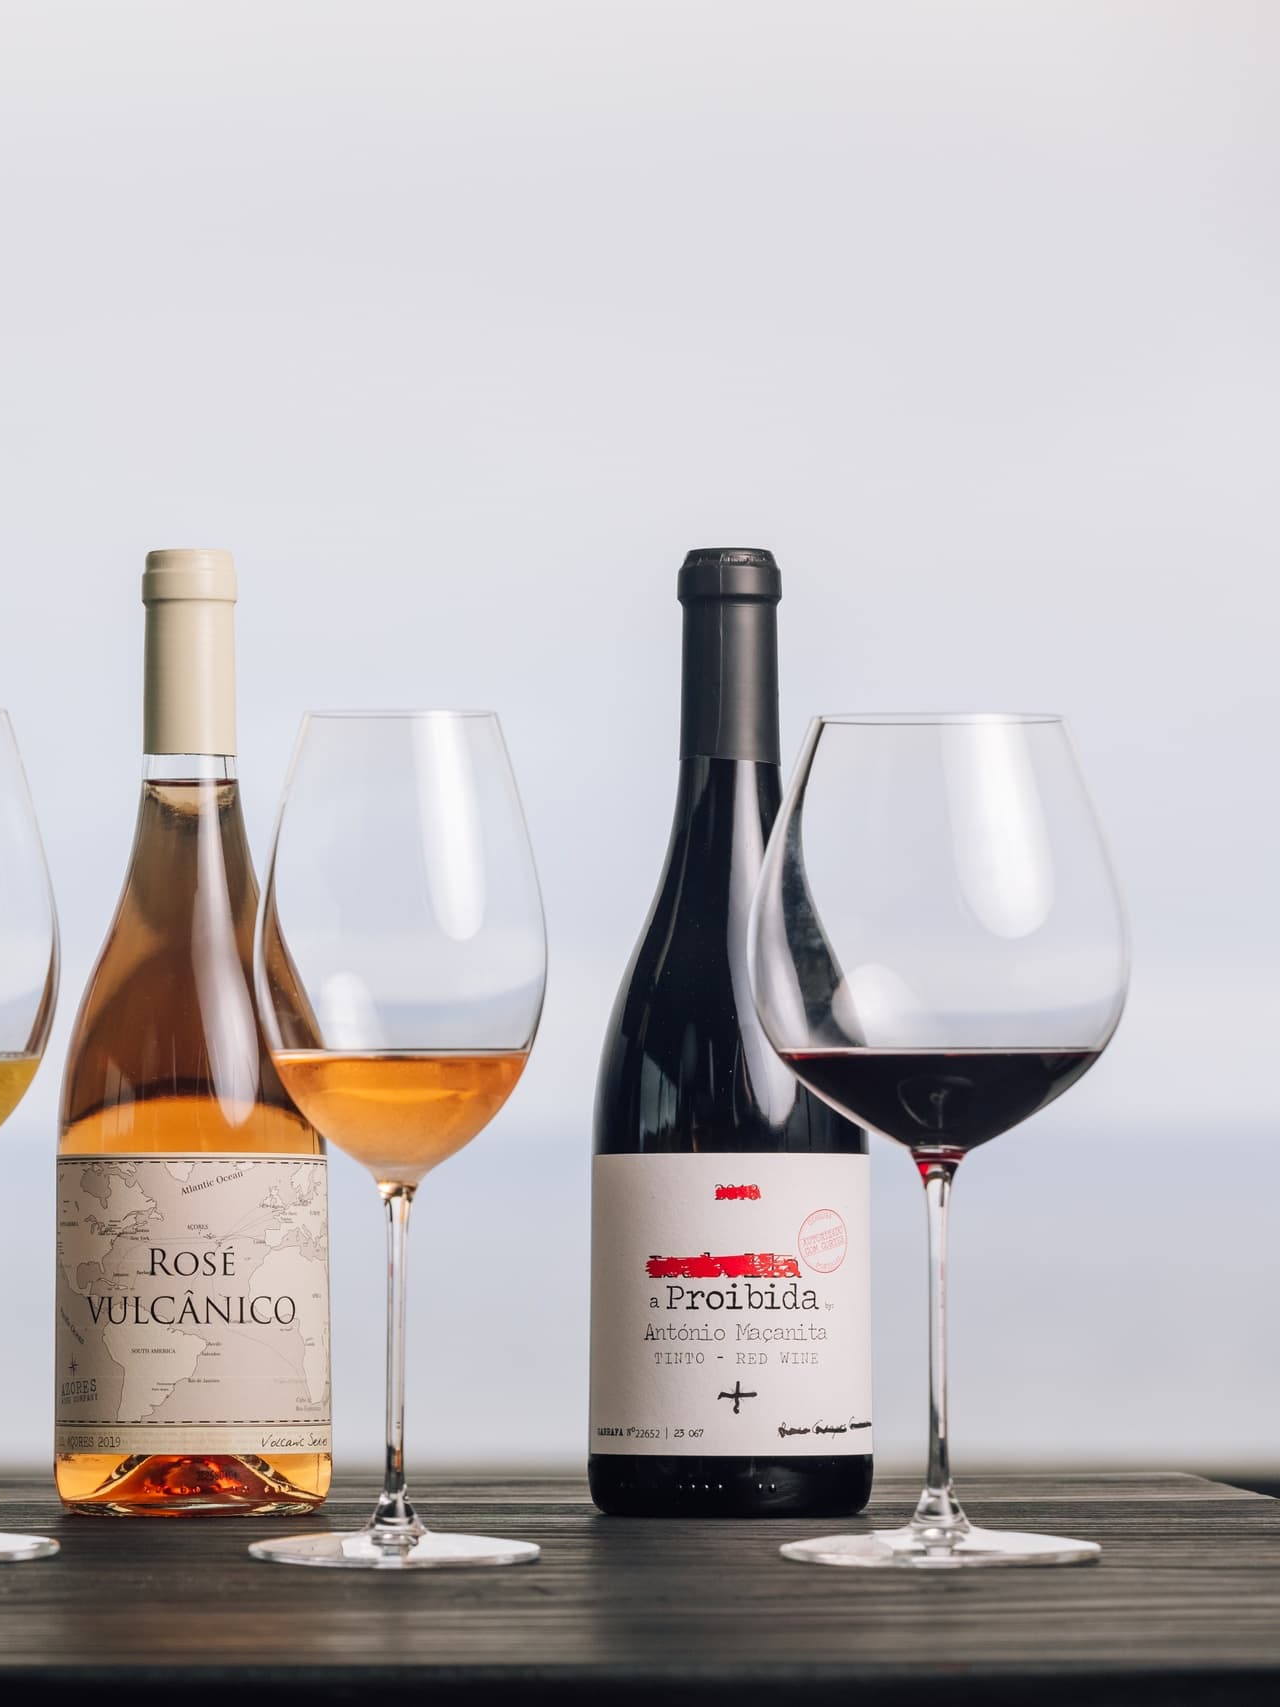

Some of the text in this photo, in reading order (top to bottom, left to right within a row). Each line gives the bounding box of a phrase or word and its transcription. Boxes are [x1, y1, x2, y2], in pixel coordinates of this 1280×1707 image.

[181, 1171, 244, 1196] Atlantic Ocean
[148, 1246, 236, 1277] ROSÉ
[87, 1289, 296, 1325] VULCÂNICO
[650, 1296, 660, 1309] a
[666, 1283, 819, 1310] Proibida
[644, 1323, 828, 1344] António Maçanita
[654, 1352, 705, 1364] TINTO
[736, 1352, 768, 1364] RED
[780, 1352, 819, 1364] WINE
[98, 1436, 121, 1448] 2019
